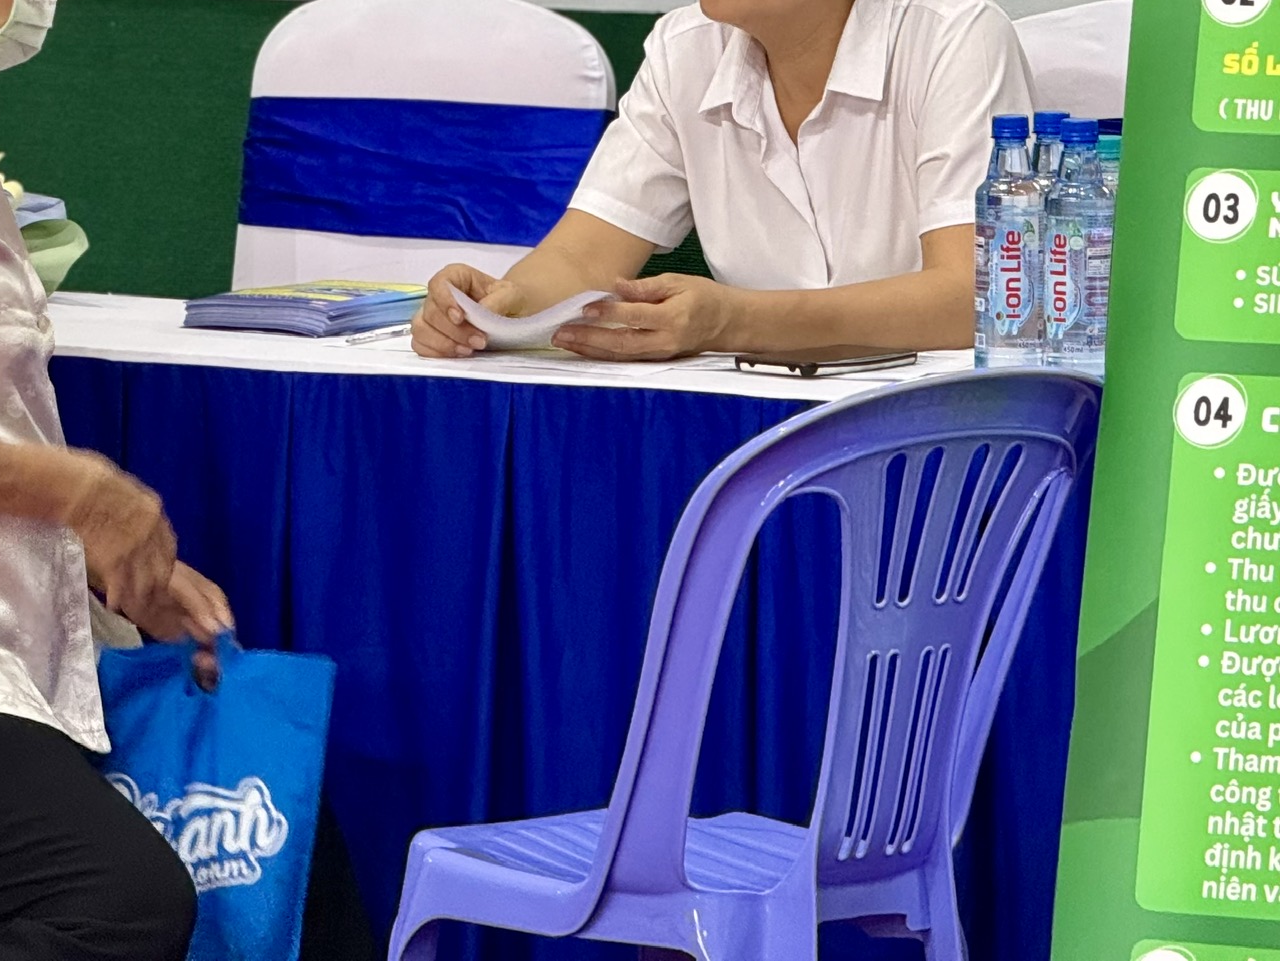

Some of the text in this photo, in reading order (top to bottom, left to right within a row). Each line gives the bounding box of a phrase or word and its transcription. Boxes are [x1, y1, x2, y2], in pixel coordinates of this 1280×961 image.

[1223, 41, 1259, 76] SỐ
[1234, 99, 1273, 120] THU
[1203, 193, 1239, 224] 03
[1000, 231, 1021, 272] Life
[1050, 234, 1067, 276] Life
[1194, 396, 1232, 428] 04
[1228, 558, 1274, 582] Thu
[1225, 589, 1267, 612] thu
[1218, 683, 1262, 708] các
[1216, 713, 1262, 740] của
[1210, 779, 1272, 811] công
[1208, 811, 1267, 842] nhật
[1205, 842, 1261, 874] định
[1202, 875, 1256, 901] niên
